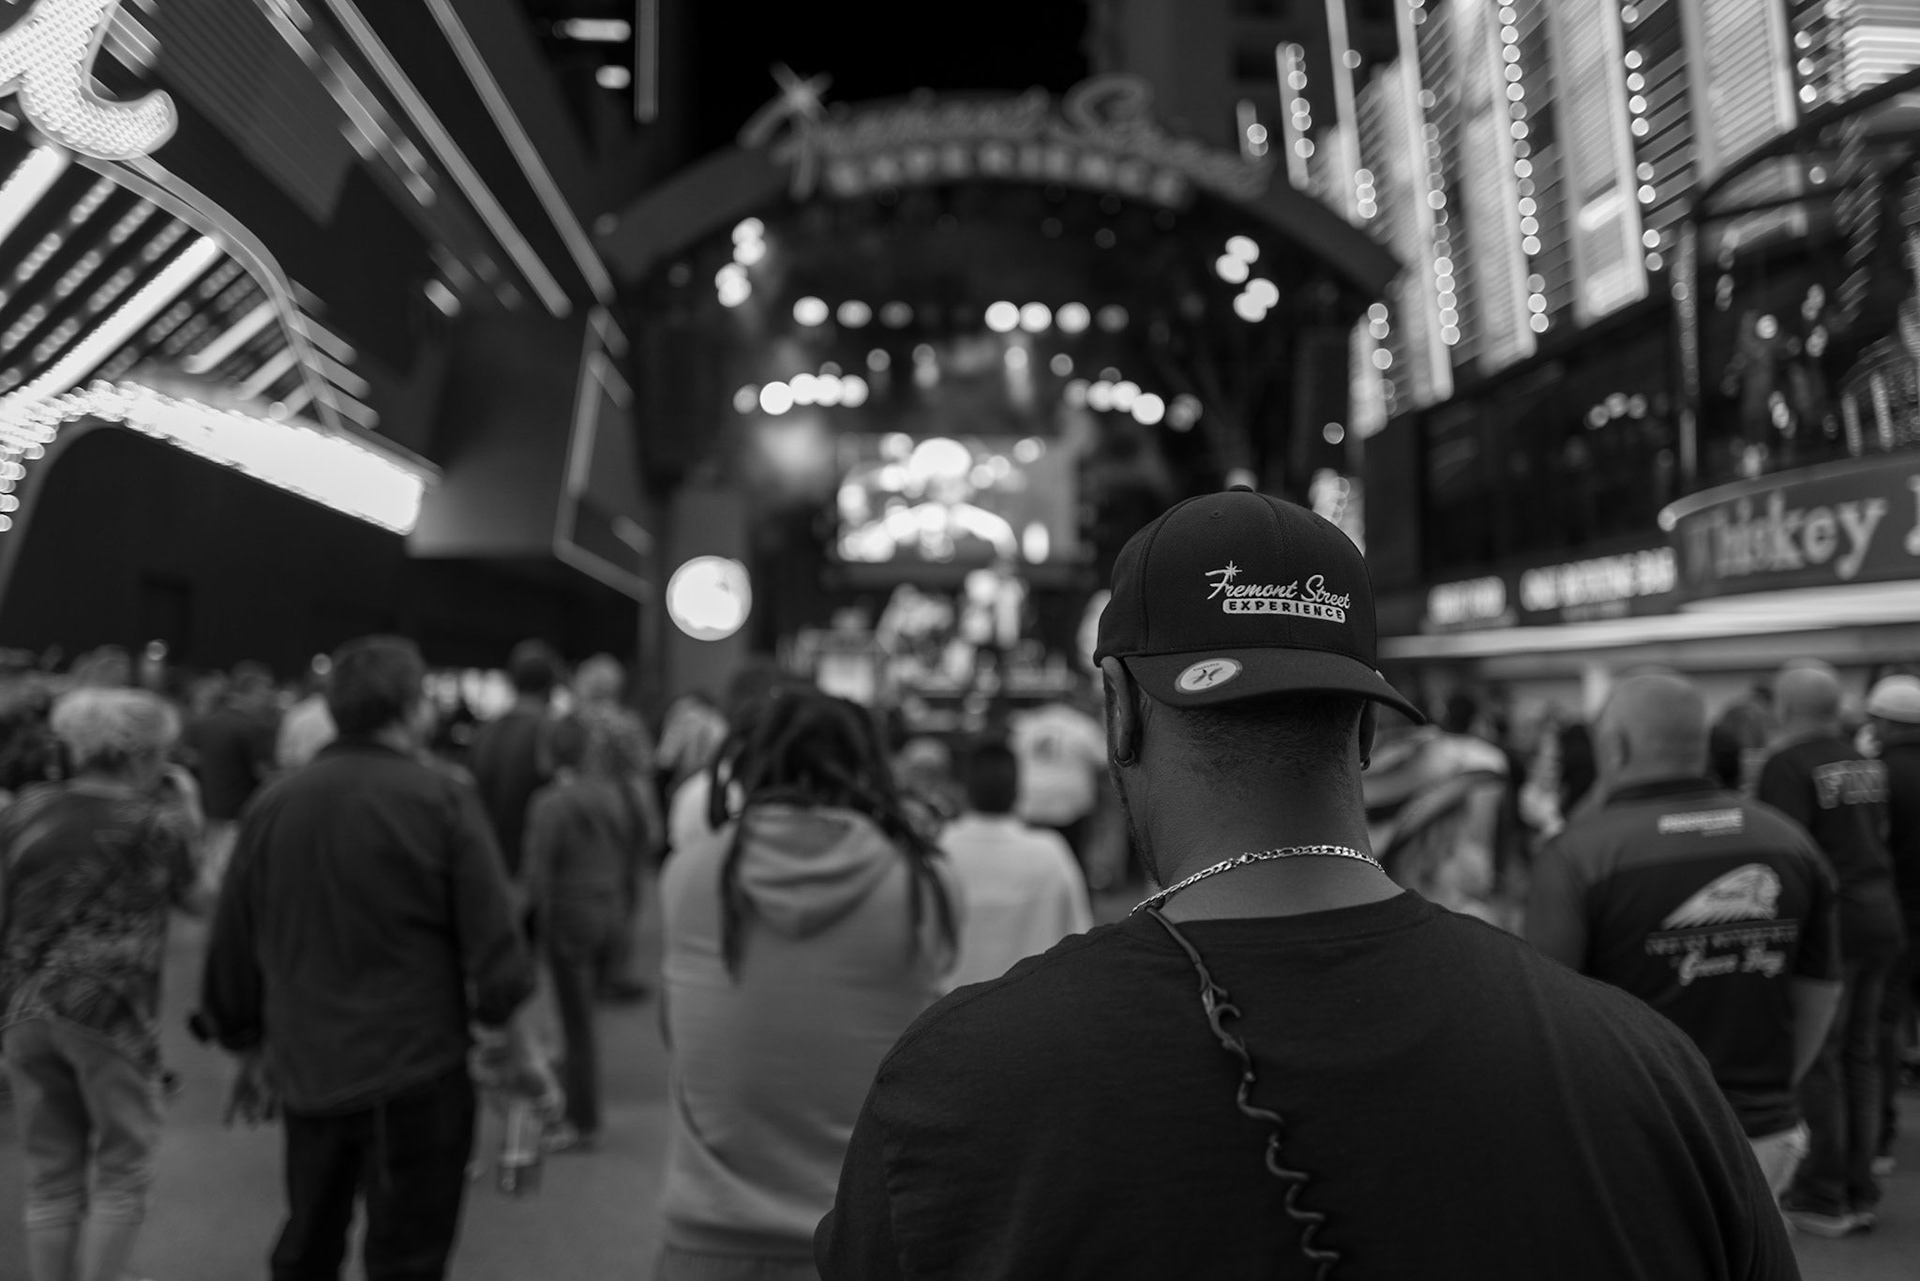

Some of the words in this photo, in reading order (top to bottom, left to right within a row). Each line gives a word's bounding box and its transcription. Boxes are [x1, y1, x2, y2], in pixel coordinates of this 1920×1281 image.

[1205, 561, 1298, 599] Fremont
[1301, 575, 1350, 609] Street
[1229, 600, 1343, 620] EXPERIENCE
